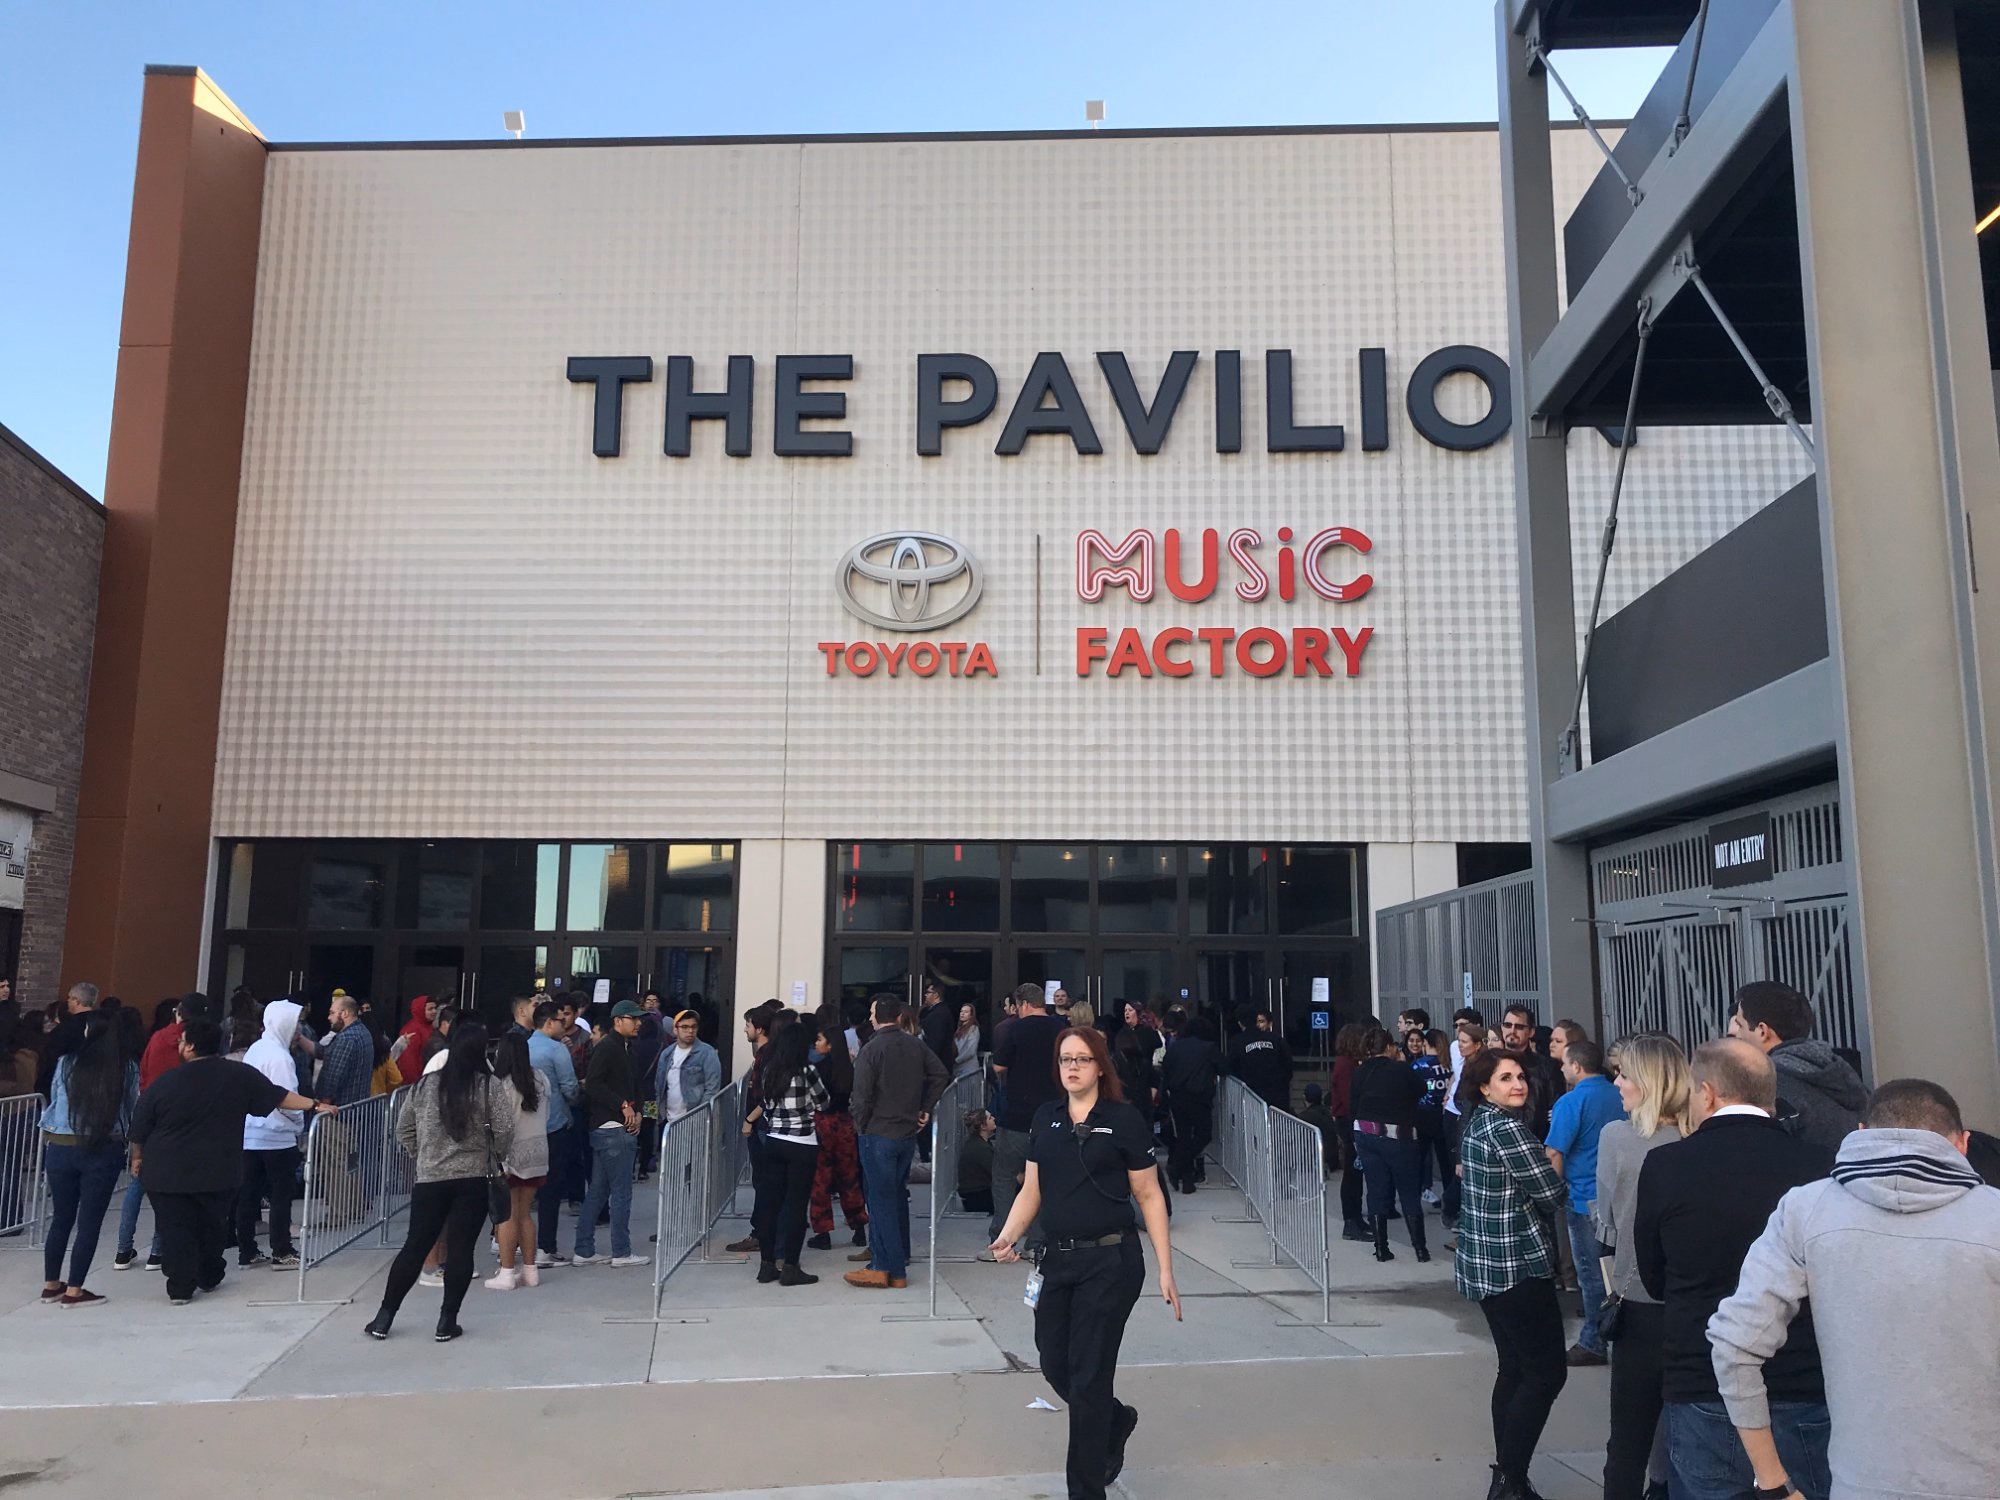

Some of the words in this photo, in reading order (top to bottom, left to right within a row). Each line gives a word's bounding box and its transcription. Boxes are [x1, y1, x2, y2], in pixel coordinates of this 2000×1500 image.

[567, 355, 853, 457] THE
[917, 345, 1637, 455] PAVILIO
[817, 642, 998, 678] TOYOTA
[1076, 627, 1374, 678] FACTORY
[1714, 842, 1728, 869] NOT
[1730, 839, 1740, 866] AN
[1740, 833, 1765, 864] ENTRY
